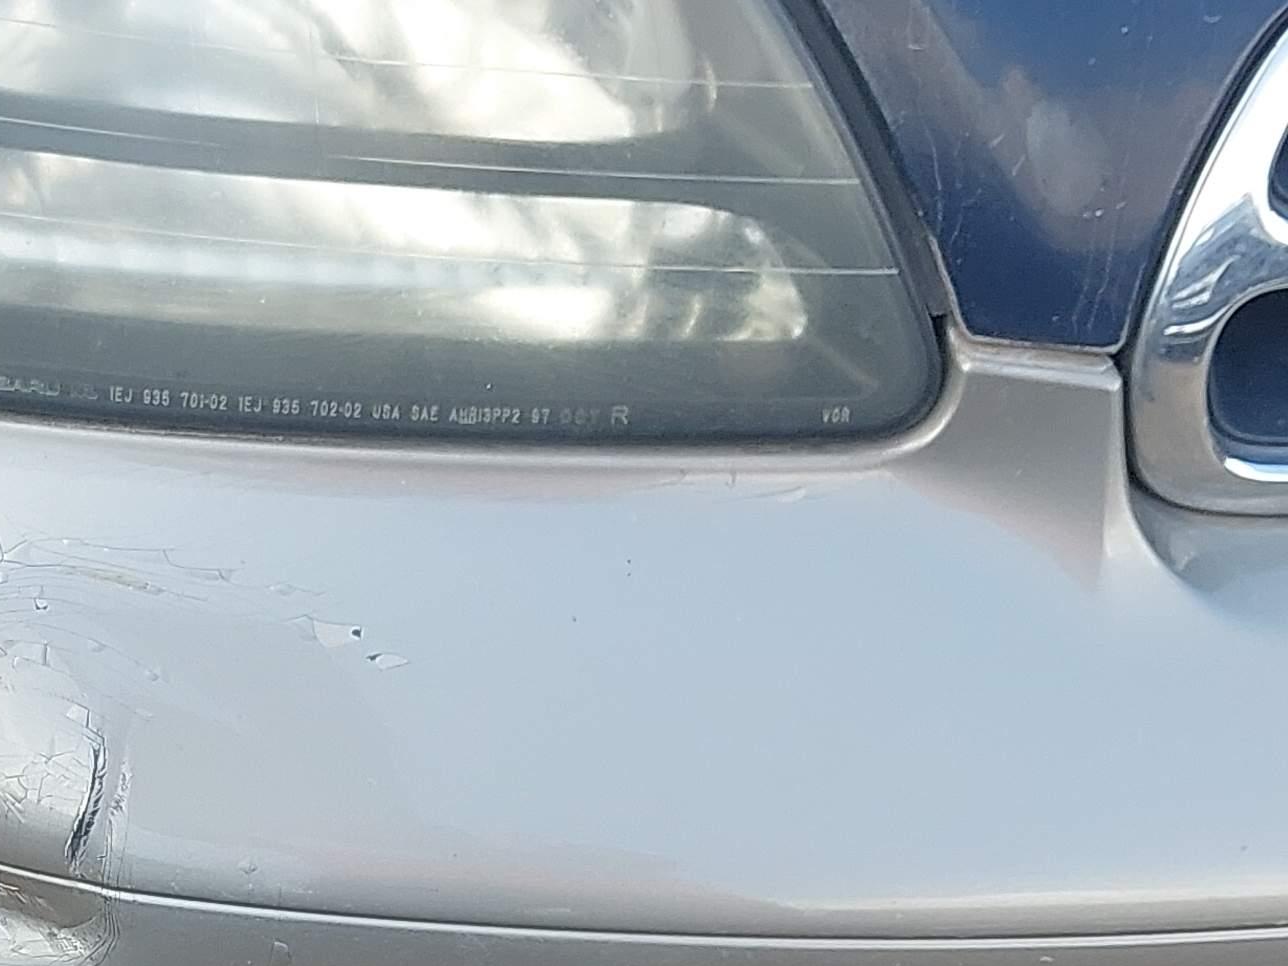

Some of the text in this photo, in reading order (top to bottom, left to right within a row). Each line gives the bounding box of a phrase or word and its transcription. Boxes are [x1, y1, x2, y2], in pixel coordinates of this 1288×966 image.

[272, 398, 300, 415] 935
[310, 400, 362, 418] 702-02
[411, 405, 439, 422] SAE
[611, 405, 629, 425] R
